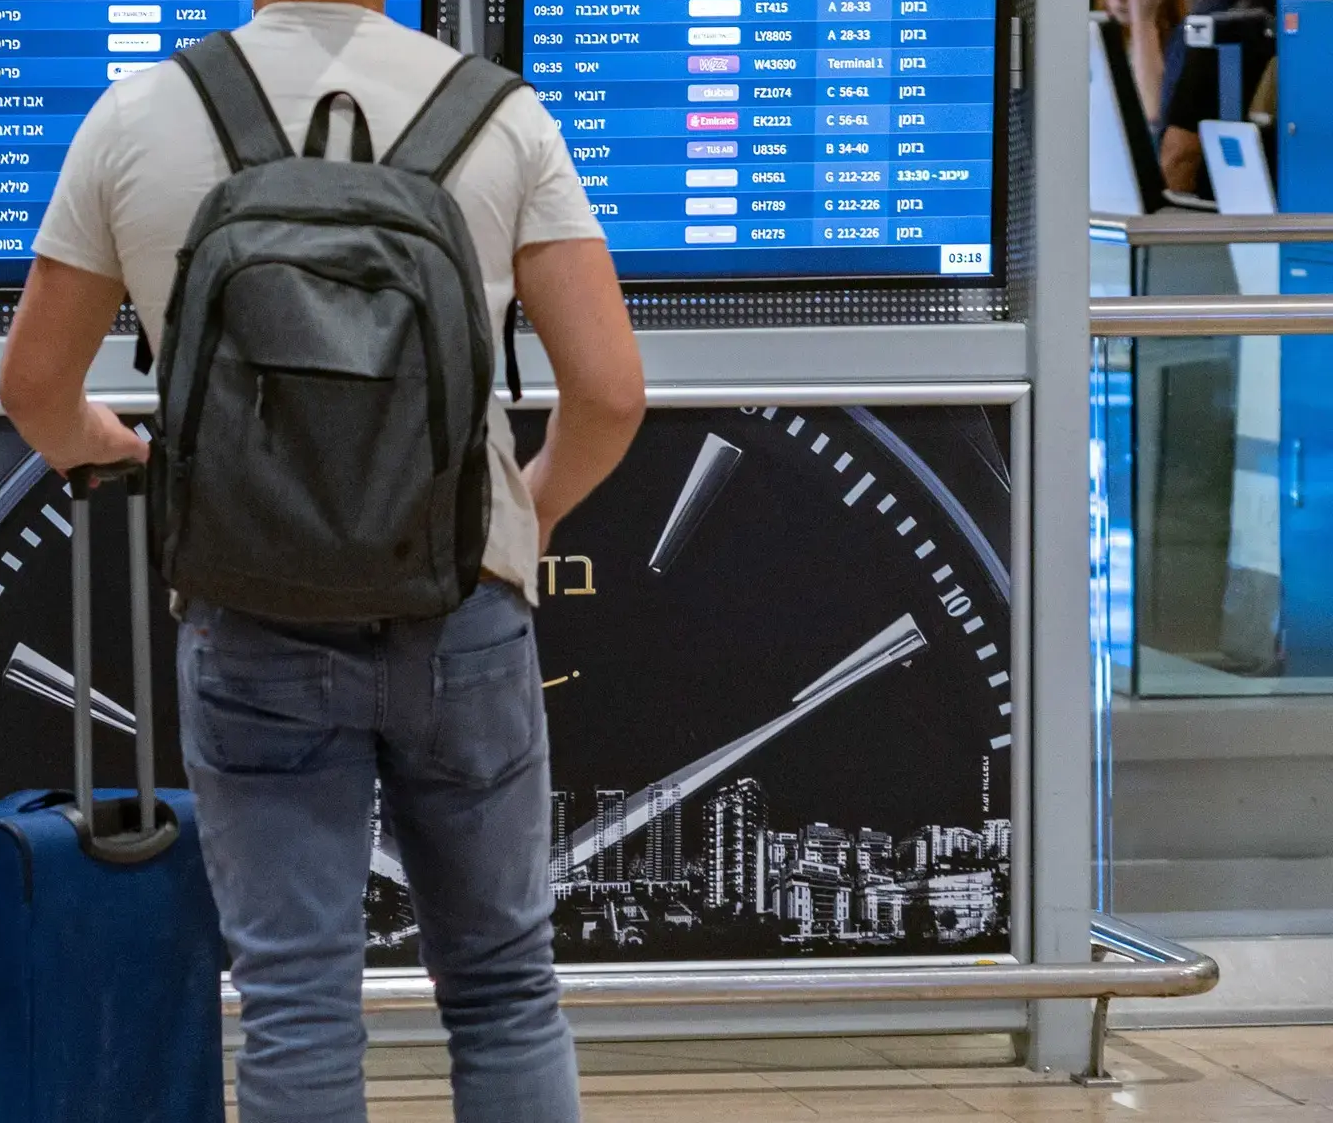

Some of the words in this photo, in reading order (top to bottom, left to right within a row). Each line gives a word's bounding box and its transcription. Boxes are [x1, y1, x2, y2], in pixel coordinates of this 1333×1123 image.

[23, 96, 44, 107] אבו
[574, 118, 606, 130] דובאי
[753, 115, 792, 127] EK2121
[826, 114, 835, 126] C
[838, 114, 870, 126] 56-61
[898, 114, 925, 128] בזמן
[948, 252, 983, 264] 03:18
[937, 583, 972, 617] 10
